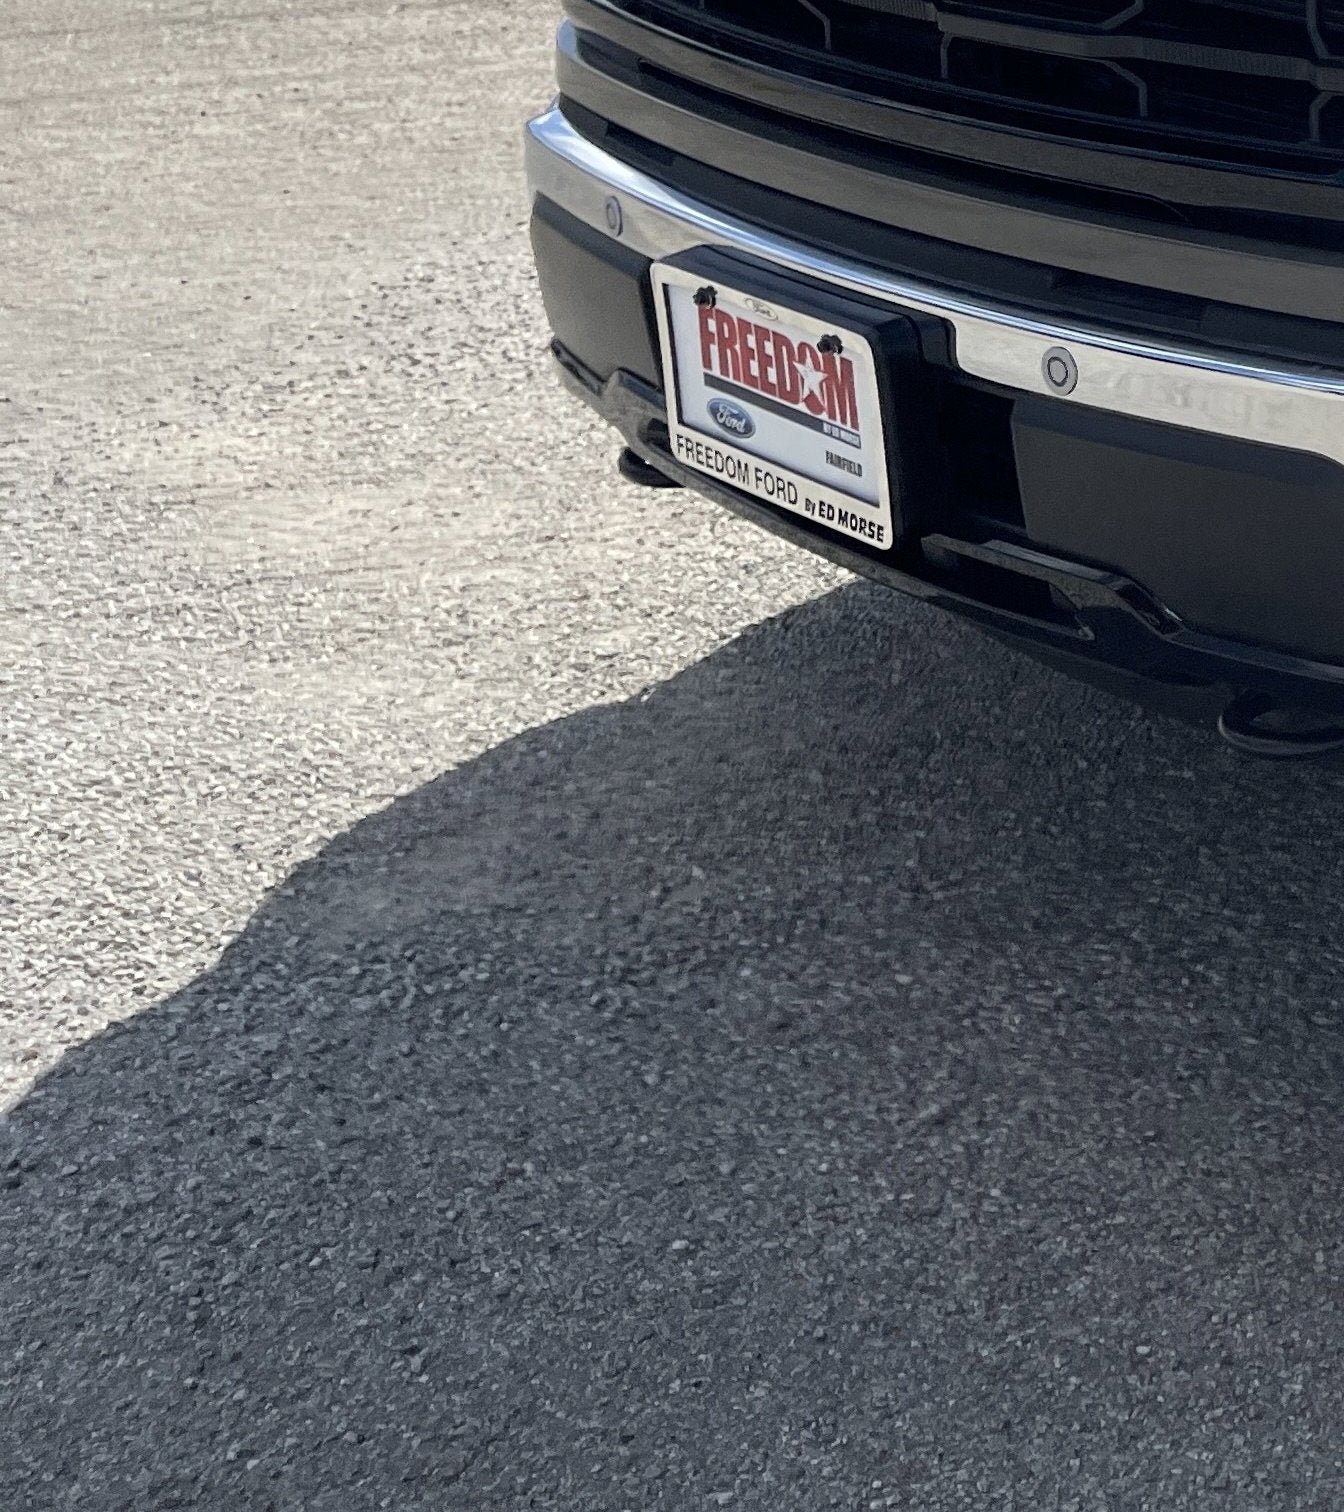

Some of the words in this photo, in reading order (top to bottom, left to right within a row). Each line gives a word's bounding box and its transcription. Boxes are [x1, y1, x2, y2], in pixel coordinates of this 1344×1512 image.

[698, 303, 859, 431] FREEDOM
[716, 402, 747, 434] Ford
[675, 434, 750, 486] FREEDOM
[755, 468, 798, 506] FORD
[819, 500, 835, 521] ED
[838, 506, 885, 543] MORSE
